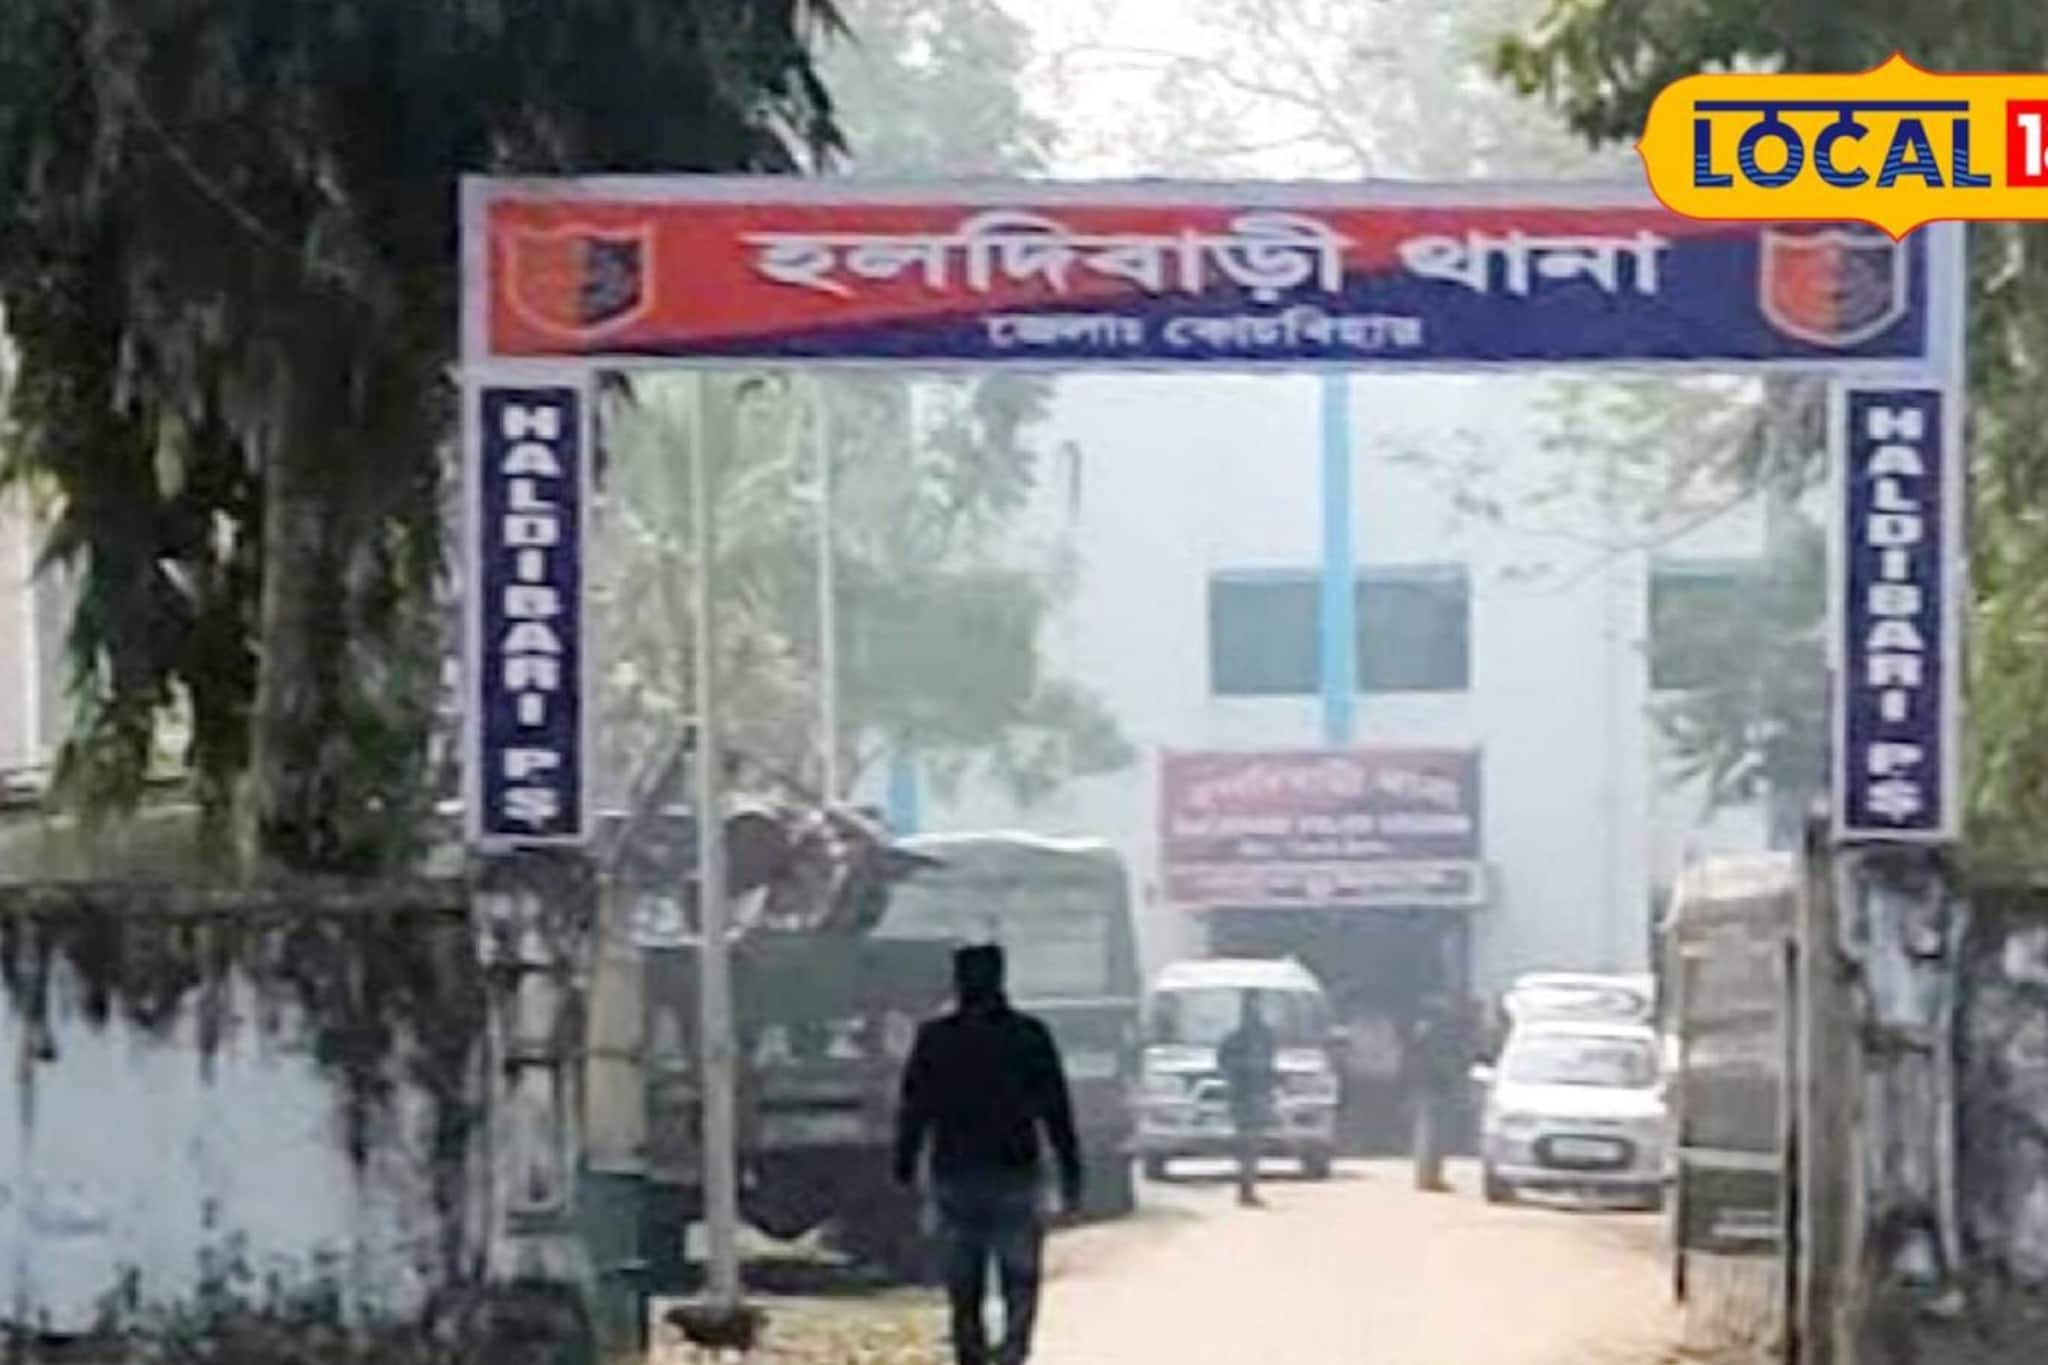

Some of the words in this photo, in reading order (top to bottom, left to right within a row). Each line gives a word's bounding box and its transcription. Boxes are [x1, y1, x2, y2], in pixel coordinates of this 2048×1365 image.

[1396, 229, 1671, 296] থানা
[501, 405, 562, 727] HALDIBARI
[1866, 406, 1925, 722] HALDIBARI
